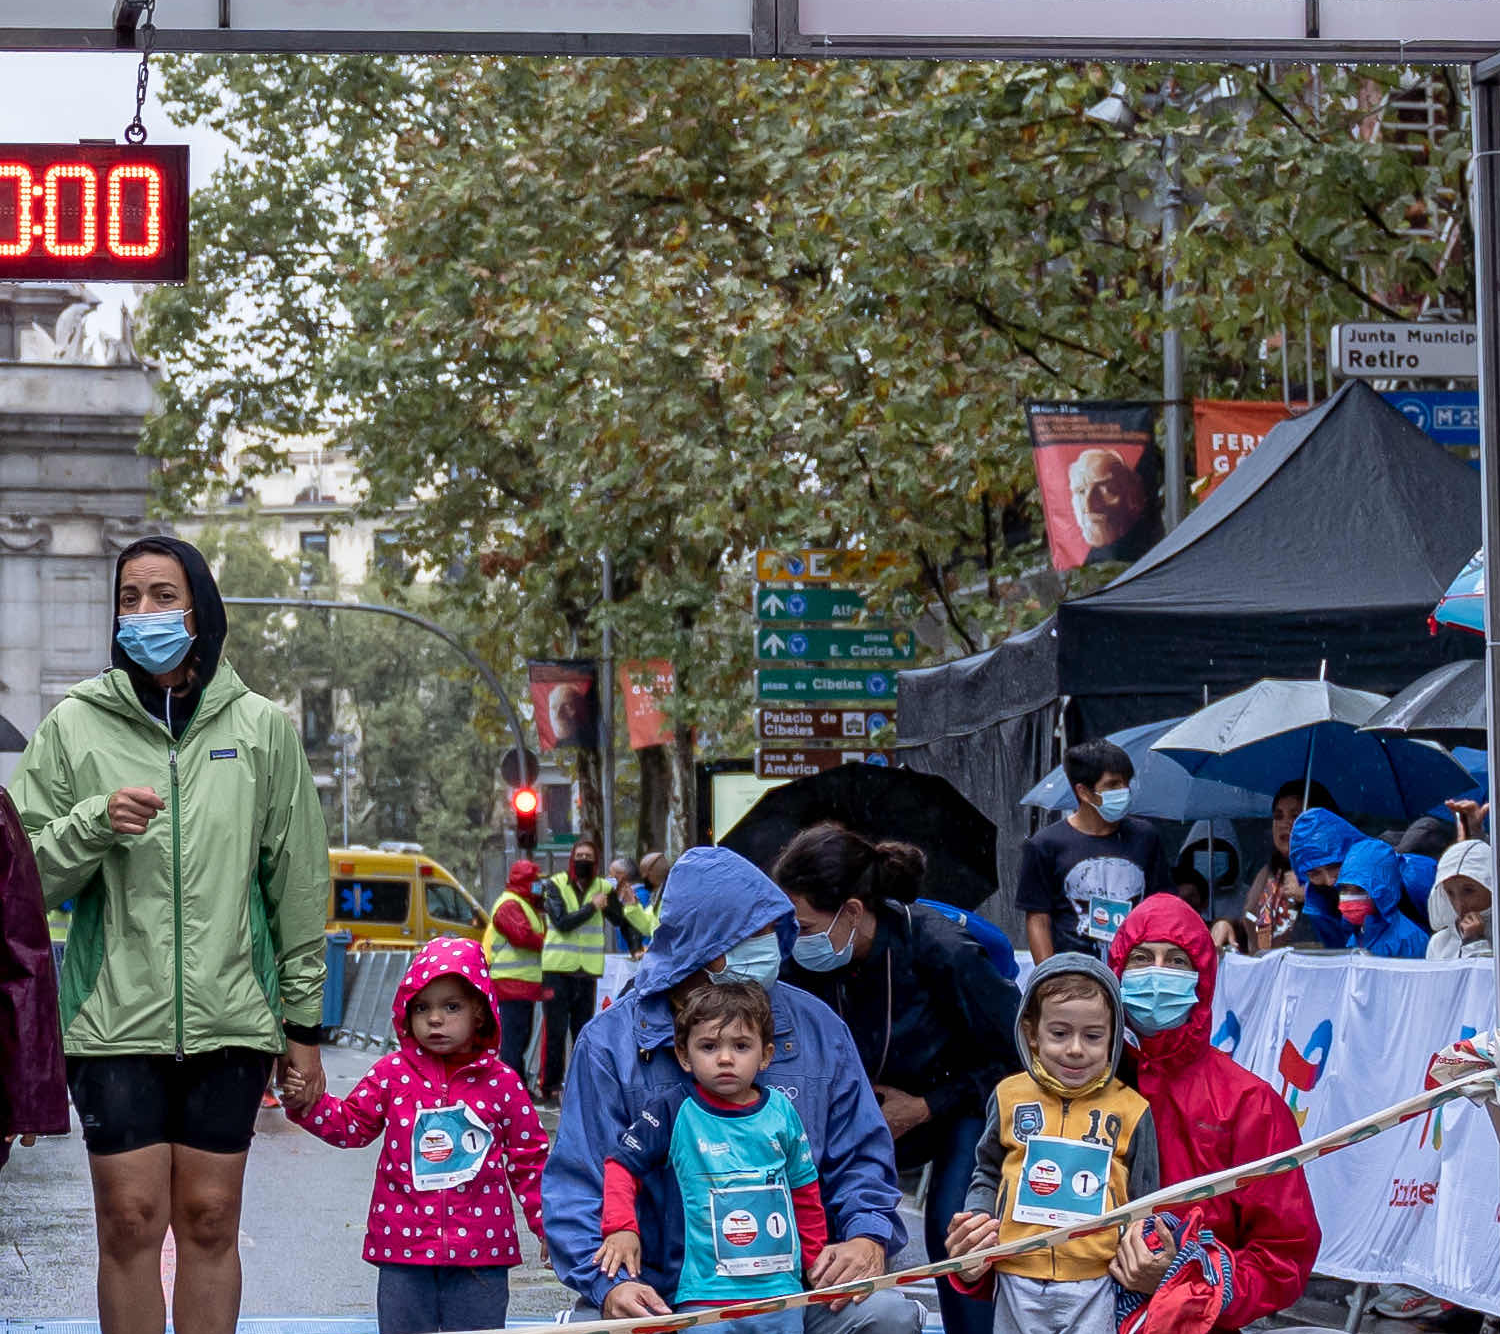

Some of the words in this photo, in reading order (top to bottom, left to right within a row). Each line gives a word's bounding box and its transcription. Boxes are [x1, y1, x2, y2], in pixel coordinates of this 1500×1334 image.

[1348, 329, 1396, 343] Junta
[1407, 329, 1477, 346] Municip
[1349, 350, 1419, 368] Retiro
[850, 645, 895, 658] Carlos
[811, 677, 864, 691] Cibeles
[763, 711, 813, 725] Palacio
[820, 711, 837, 724] de
[763, 723, 815, 737] Cibeles
[763, 761, 820, 777] América
